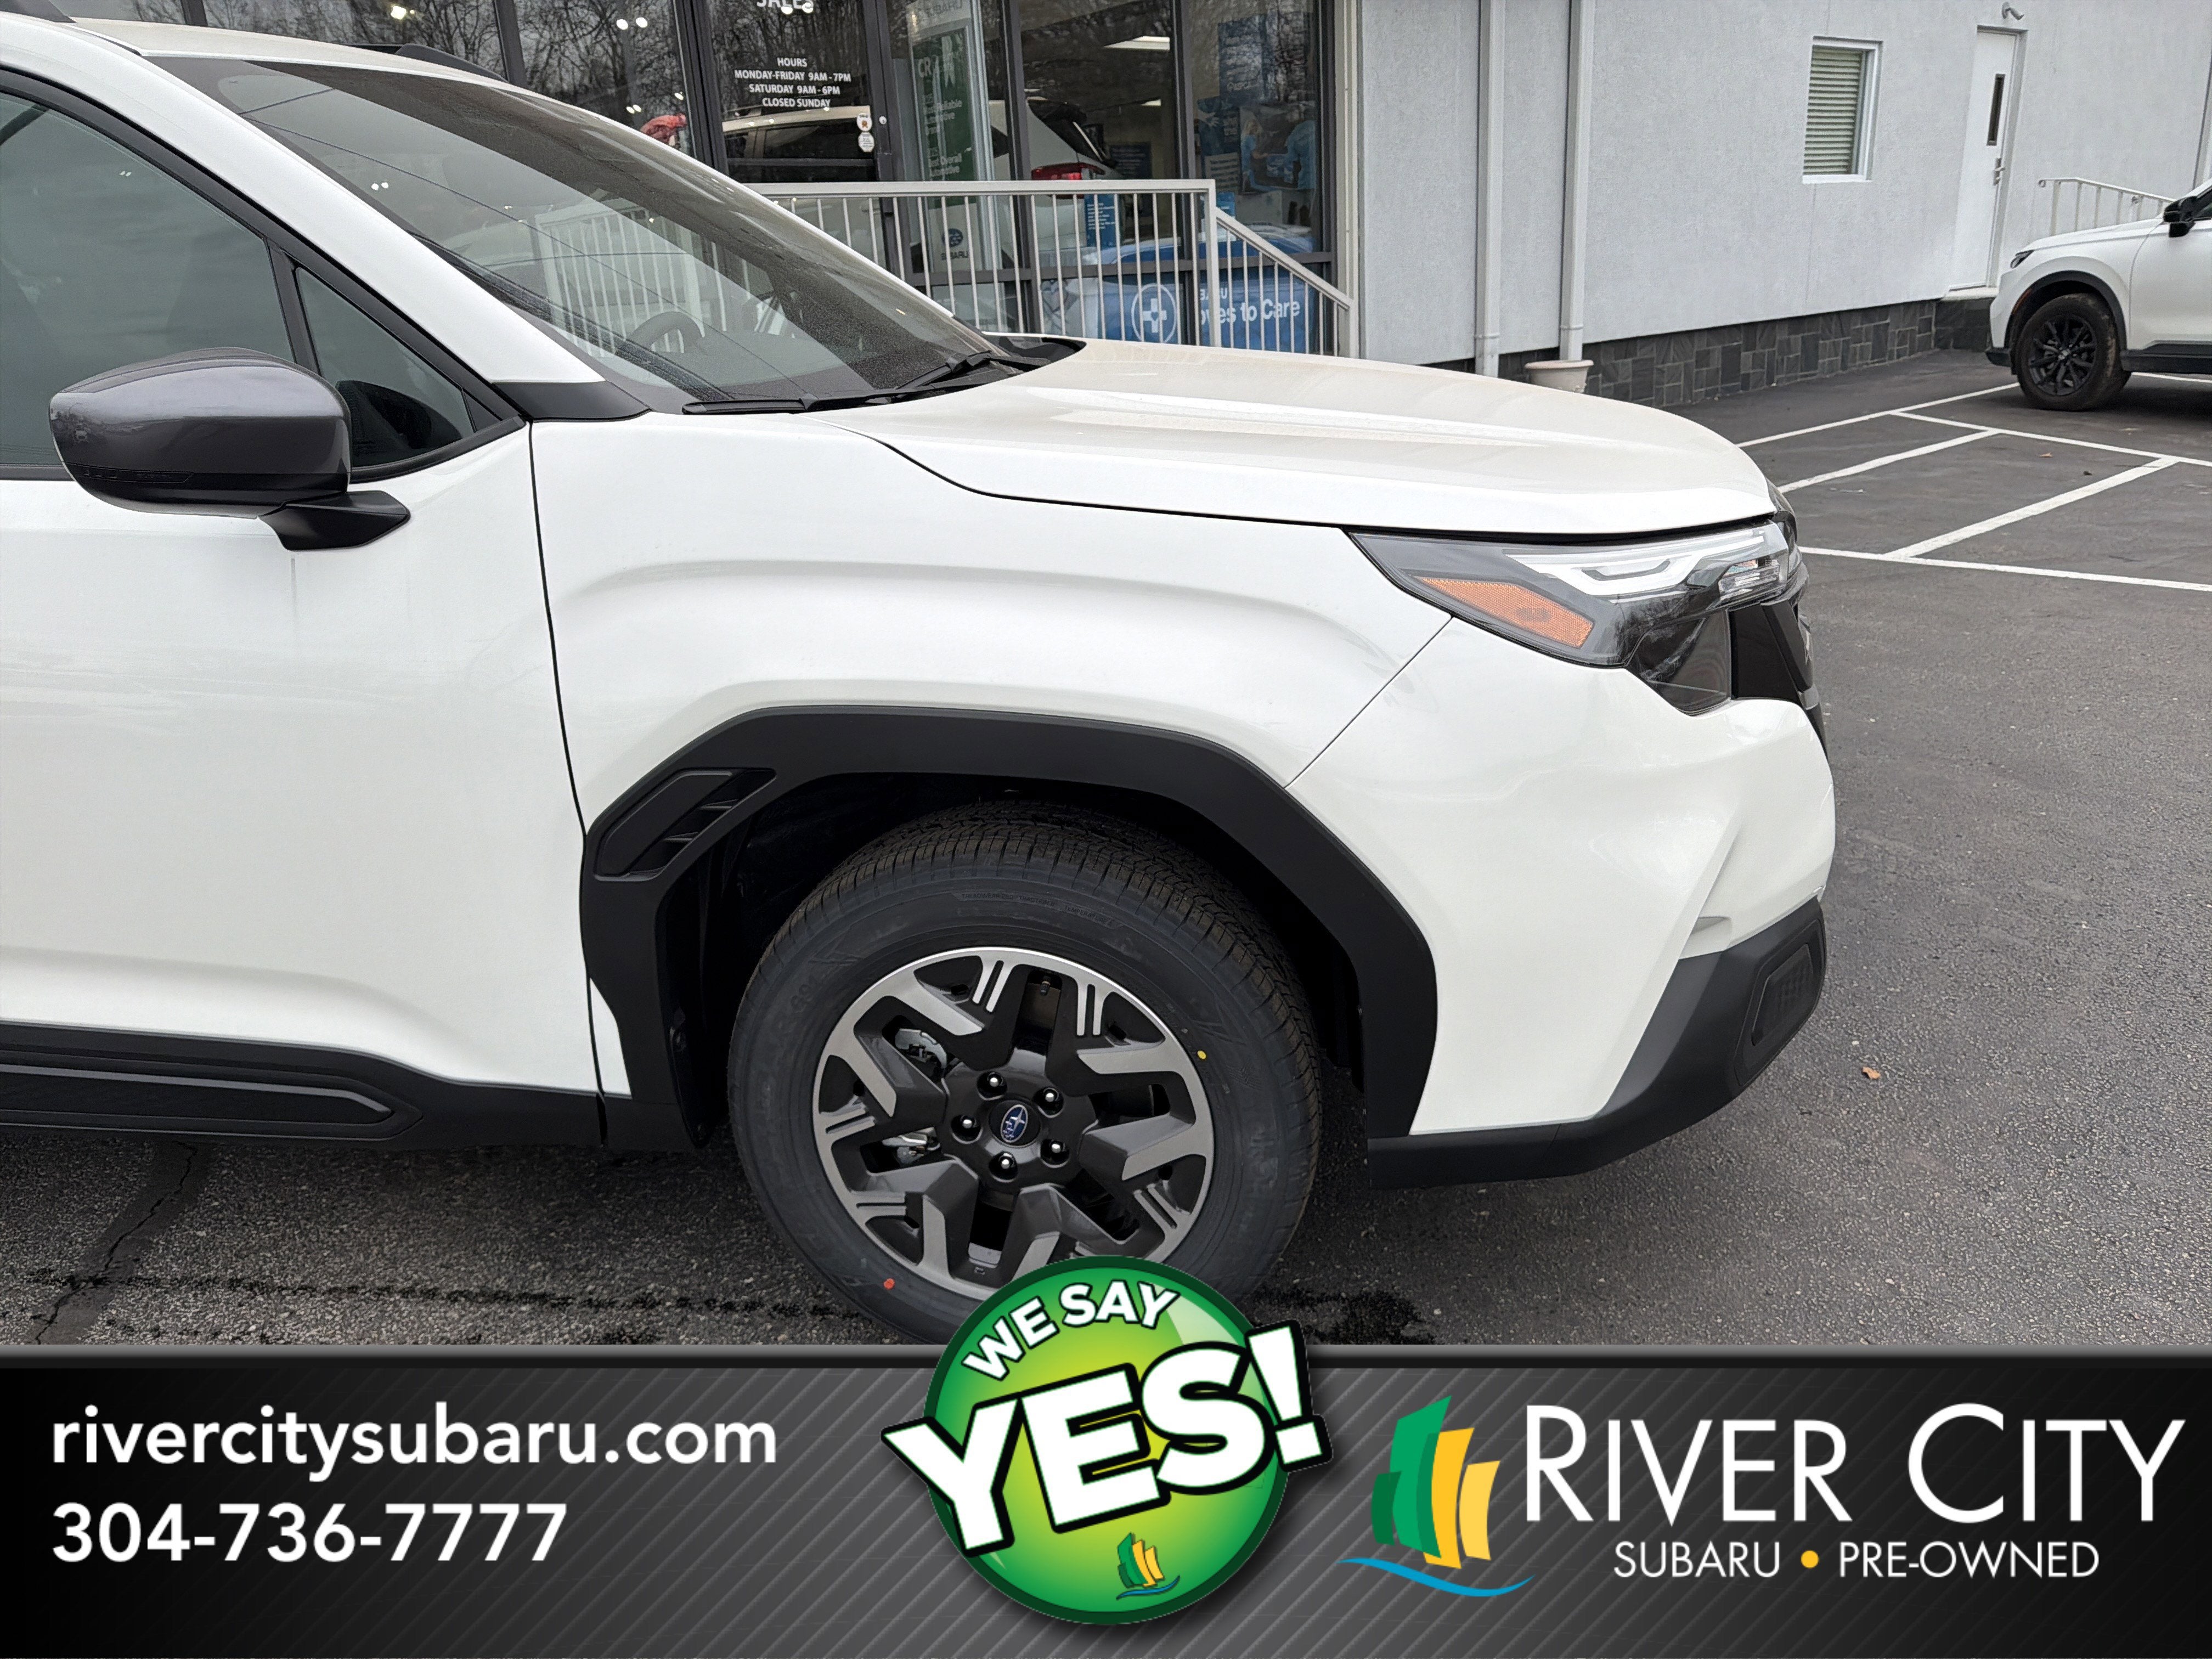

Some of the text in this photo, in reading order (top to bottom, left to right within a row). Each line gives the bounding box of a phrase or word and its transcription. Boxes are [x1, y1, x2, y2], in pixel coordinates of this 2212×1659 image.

[777, 57, 808, 67] HOURS
[734, 69, 805, 81] MONDAY-FRIDAY
[808, 72, 828, 81] 9AM
[833, 73, 851, 82] 7PM
[749, 83, 794, 93] SATURDAY
[797, 85, 816, 94] 9AM
[822, 86, 840, 95] 6PM
[762, 97, 831, 108] CLOSED SUNDAY
[1240, 302, 1257, 321] to
[1262, 298, 1300, 320] Care
